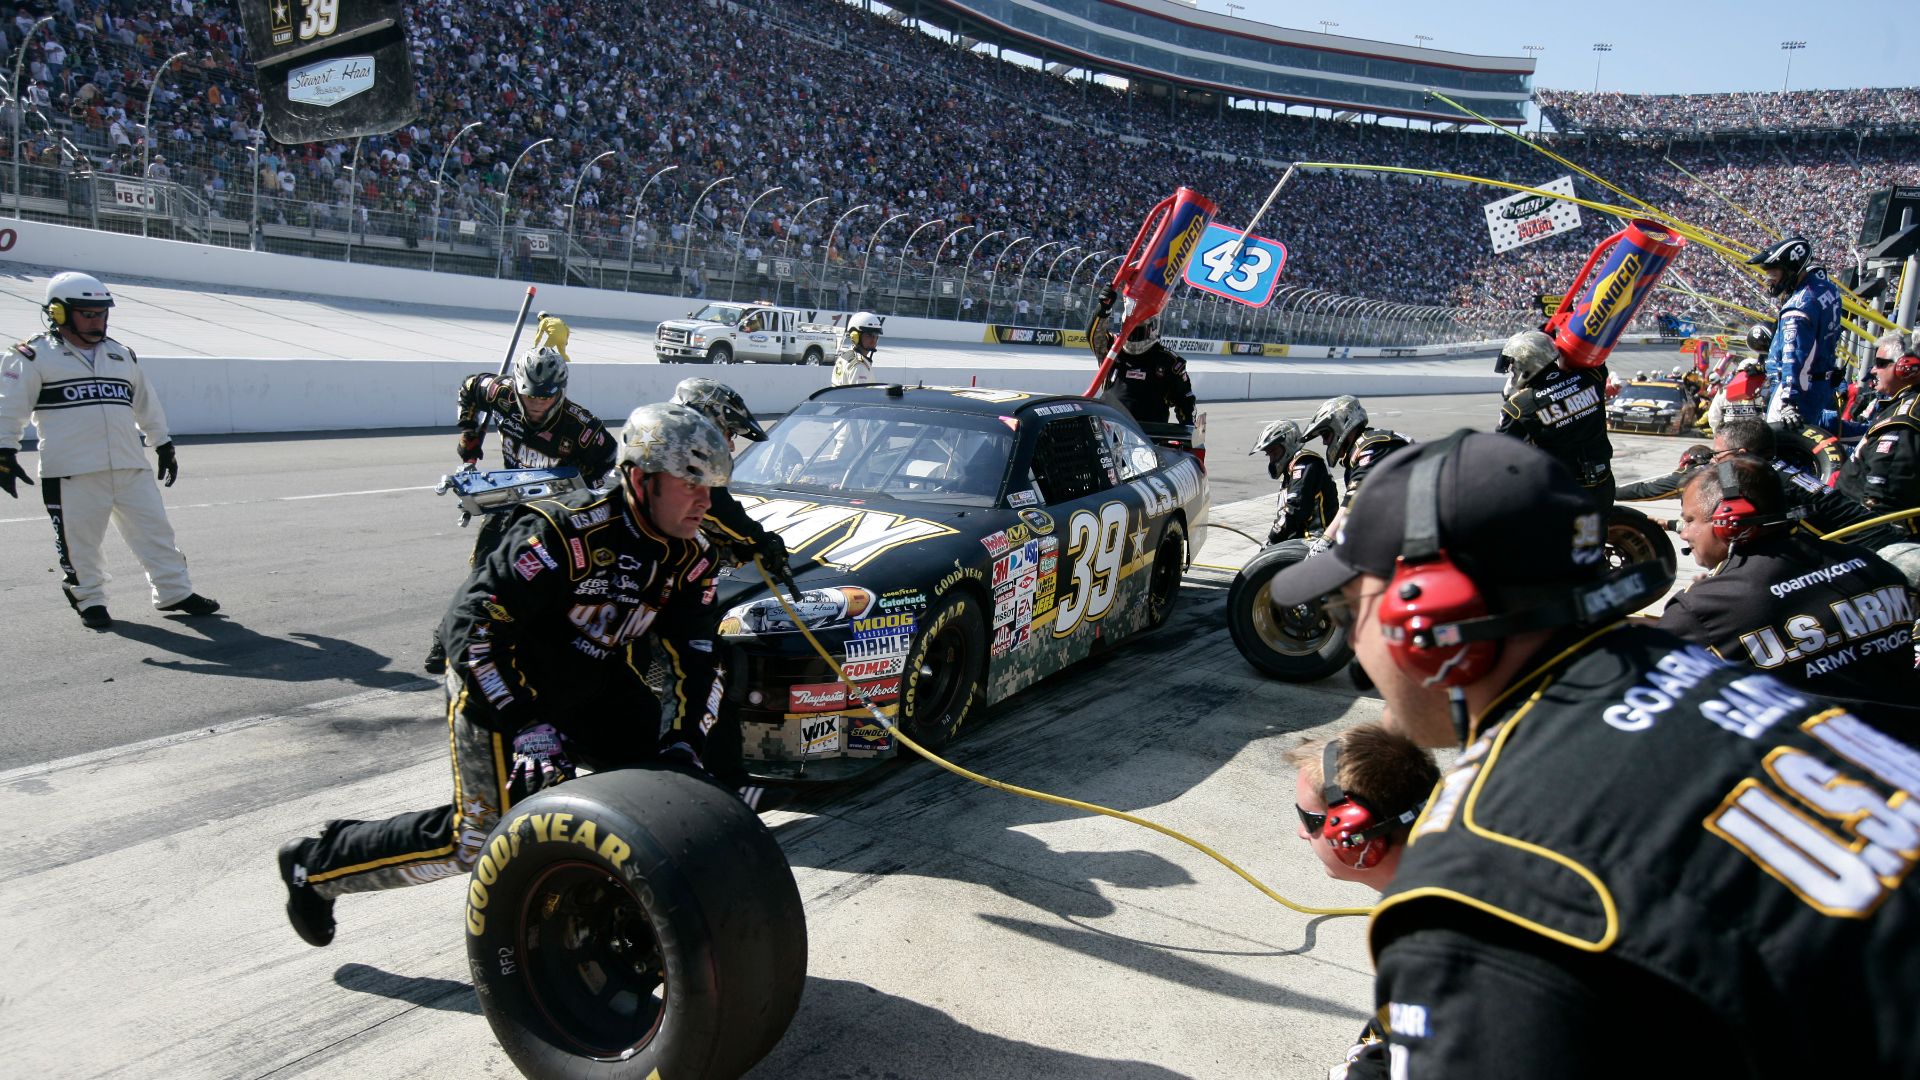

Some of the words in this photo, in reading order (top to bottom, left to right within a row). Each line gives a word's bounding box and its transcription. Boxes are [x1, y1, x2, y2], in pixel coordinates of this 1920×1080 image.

[300, 0, 338, 40] 39
[291, 69, 335, 90] Stewart
[342, 62, 371, 81] Haas
[1519, 220, 1553, 238] GUARD
[1165, 220, 1204, 283] SUNOCO
[1790, 245, 1806, 262] 43
[1202, 240, 1272, 292] 43
[1586, 257, 1640, 335] SUNOCO
[1011, 330, 1034, 341] NASCAR
[1036, 331, 1055, 344] Sprint
[1179, 341, 1208, 352] SPEEDWAY
[63, 384, 131, 400] OFFICIAL
[1536, 375, 1582, 398] GOARMY.COM
[1549, 384, 1580, 402] MOORE
[1537, 403, 1568, 426] U.S.
[1565, 385, 1600, 414] ARMY
[1556, 416, 1573, 428] ARMY
[1575, 406, 1598, 420] STRONG
[517, 443, 562, 469] ARMY
[1802, 429, 1841, 462] EALE
[1127, 475, 1179, 519] U.S.
[731, 494, 961, 571] MY
[934, 558, 983, 596] GOODYEAR
[993, 557, 1009, 586] 3M
[1053, 500, 1130, 639] 39
[1770, 557, 1867, 598] goarmy.com
[879, 594, 926, 608] Gatorback
[882, 589, 917, 597] GOODYEAR
[813, 603, 835, 613] Haas
[885, 604, 927, 614] BELTS
[995, 608, 1014, 623] TISSOT
[1033, 594, 1054, 616] JEGS
[853, 612, 913, 632] MOOG
[569, 636, 611, 660] ARMY
[846, 635, 909, 658] MAHLE
[1739, 614, 1841, 669] U.S.
[842, 660, 890, 677] COMP
[1806, 645, 1856, 678] ARMY
[793, 690, 845, 706] Raybestos
[848, 681, 899, 701] Eelbrock
[802, 718, 837, 742] WIX
[852, 729, 889, 737] SUNOCO
[467, 813, 631, 936] GOODYEAR
